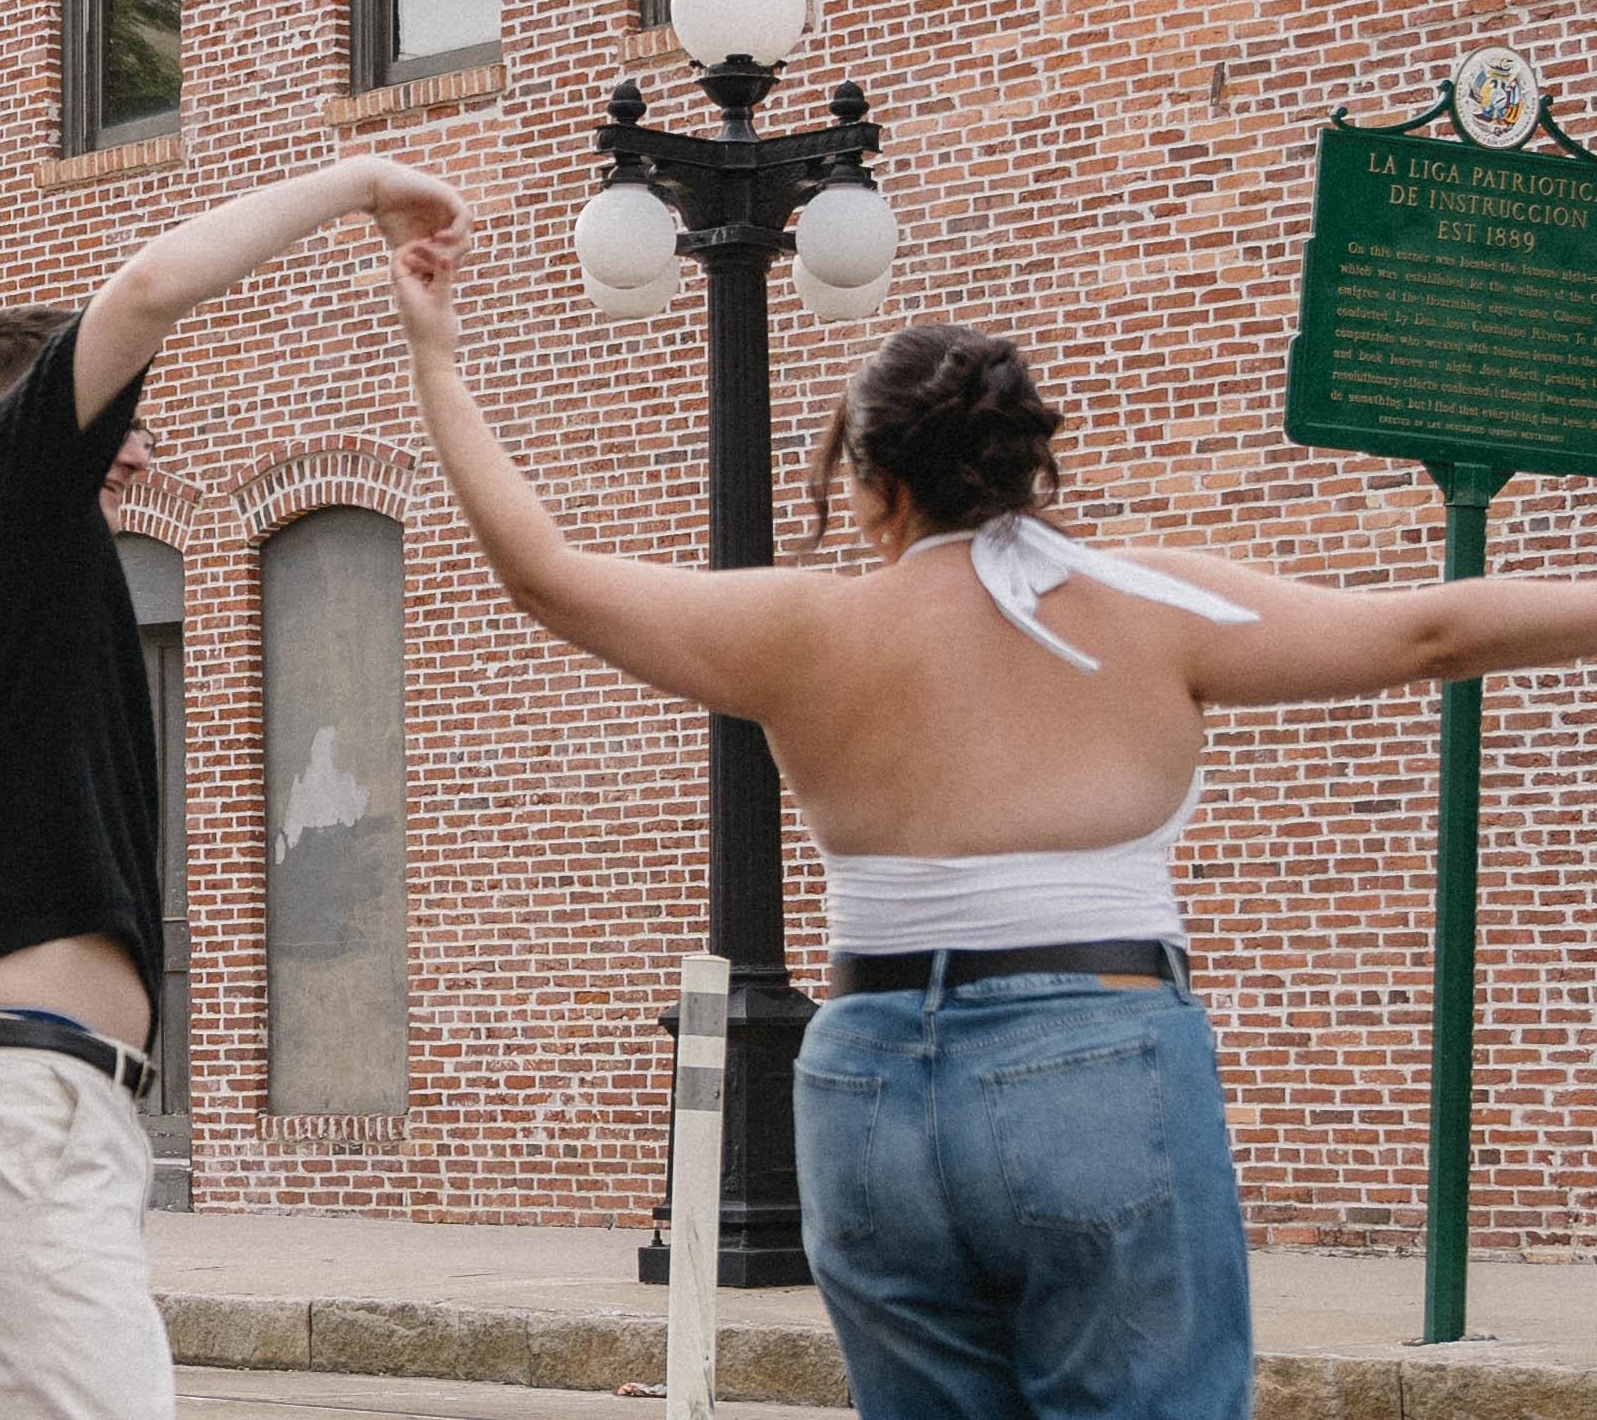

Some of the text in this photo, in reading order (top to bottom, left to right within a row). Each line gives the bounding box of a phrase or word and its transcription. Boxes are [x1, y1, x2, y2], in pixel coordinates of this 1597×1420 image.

[1367, 153, 1396, 174] LA
[1408, 159, 1460, 183] LIGA
[1388, 185, 1587, 229] DE INSTRUCCION
[1485, 227, 1534, 252] 1889
[1348, 242, 1364, 253] On
[1370, 245, 1389, 257] this
[1397, 251, 1429, 261] corner
[1500, 262, 1516, 273] the
[1340, 263, 1371, 275] which
[1489, 281, 1506, 291] the
[1554, 289, 1563, 299] of
[1570, 291, 1584, 302] the
[1386, 290, 1395, 300] of
[1402, 292, 1417, 302] the
[1336, 307, 1387, 320] conducted
[1394, 311, 1407, 325] by
[1333, 349, 1351, 358] and
[1359, 349, 1382, 362] book
[1399, 335, 1419, 345] who
[1466, 343, 1487, 353] with
[1581, 355, 1597, 366] the
[1332, 370, 1399, 388] revolutionary
[1435, 401, 1455, 413] find
[1460, 404, 1478, 415] that
[1482, 409, 1537, 424] everything
